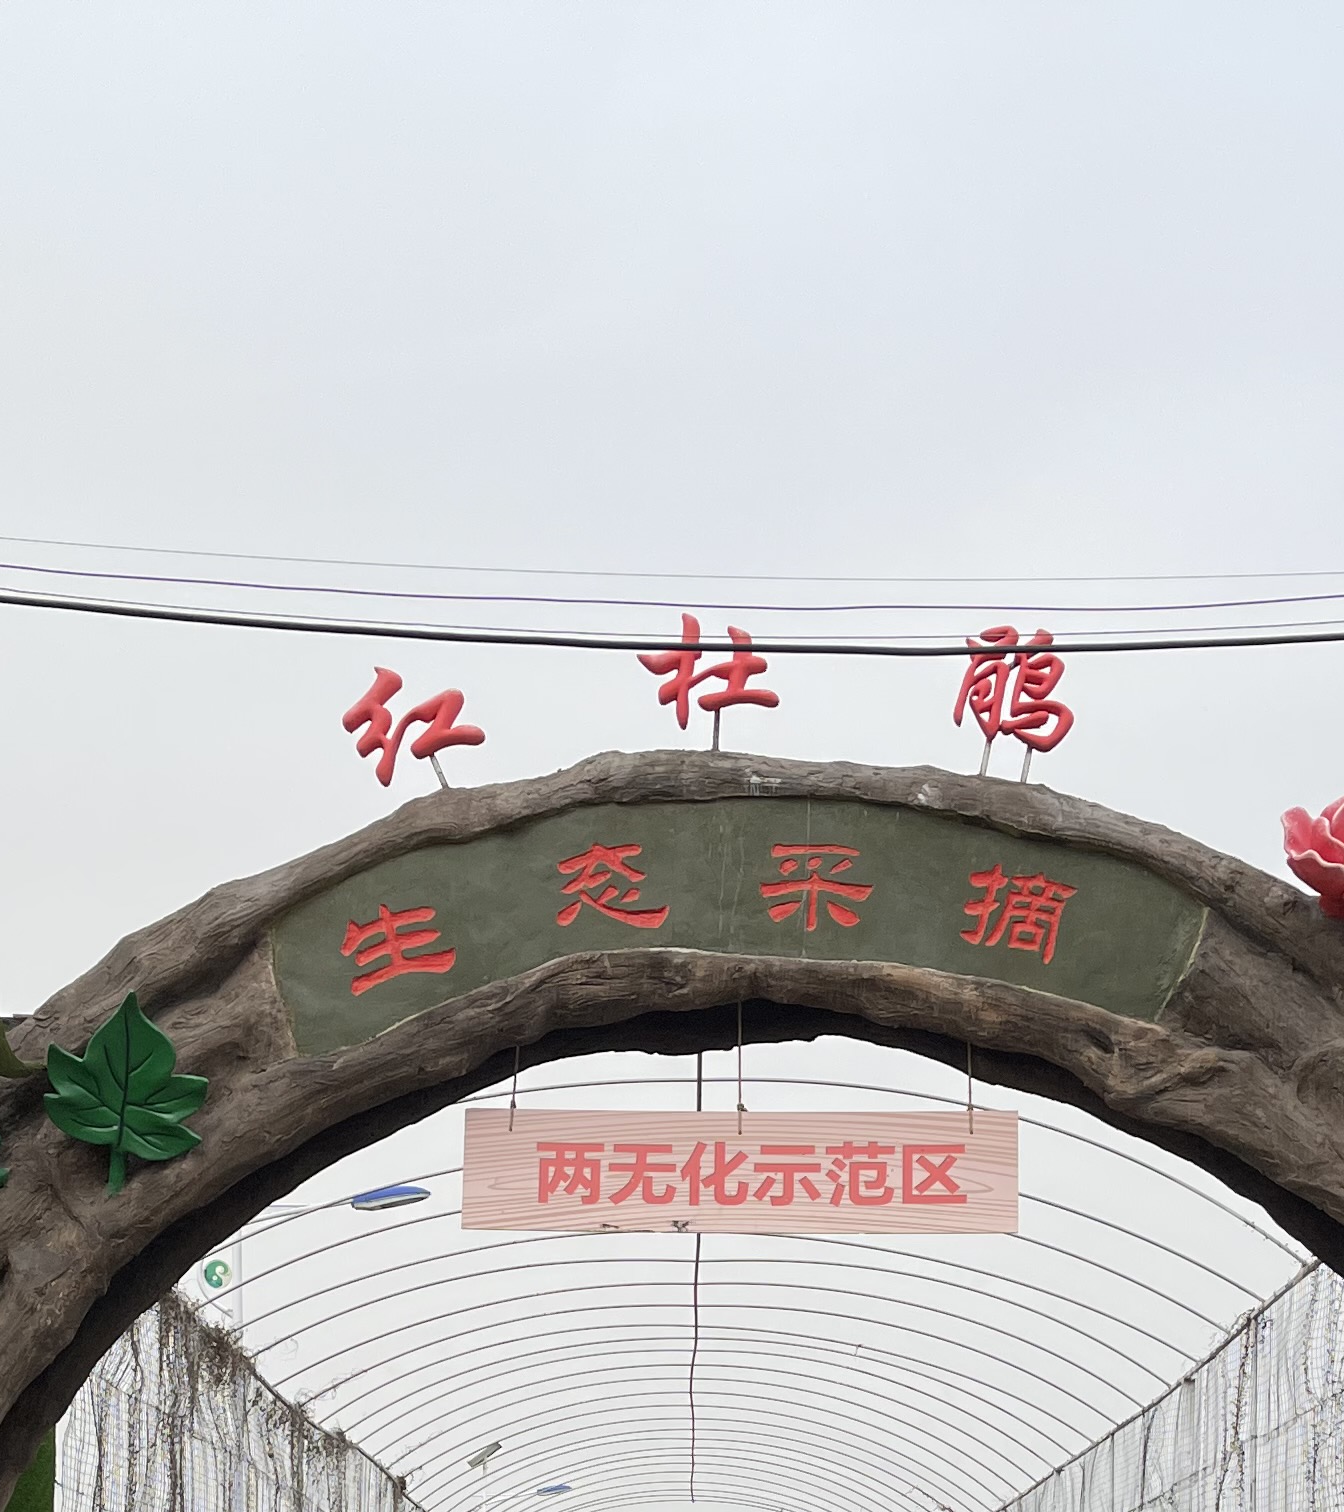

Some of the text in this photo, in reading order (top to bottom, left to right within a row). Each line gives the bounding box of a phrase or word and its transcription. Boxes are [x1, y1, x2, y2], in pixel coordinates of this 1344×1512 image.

[342, 613, 1074, 787] 红杜鹃
[340, 843, 1078, 997] 生态采摘
[536, 1142, 967, 1207] 两无化示范区
